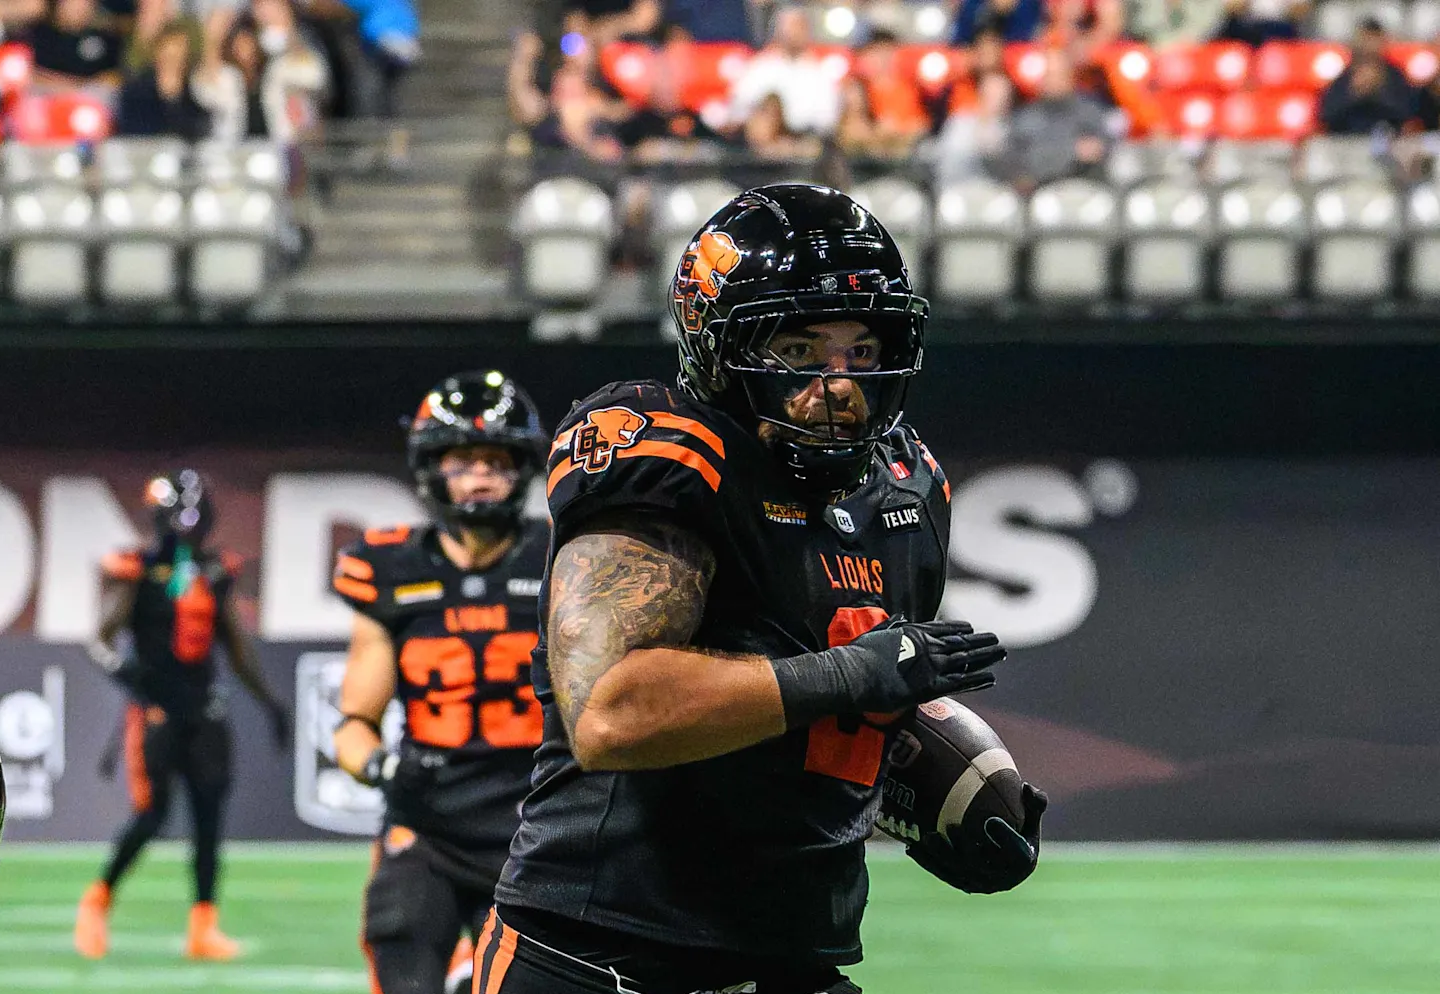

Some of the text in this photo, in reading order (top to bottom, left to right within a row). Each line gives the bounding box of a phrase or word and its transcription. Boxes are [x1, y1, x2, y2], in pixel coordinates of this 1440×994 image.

[575, 425, 612, 473] BC
[881, 507, 920, 529] TELUS
[818, 552, 884, 595] LIONS
